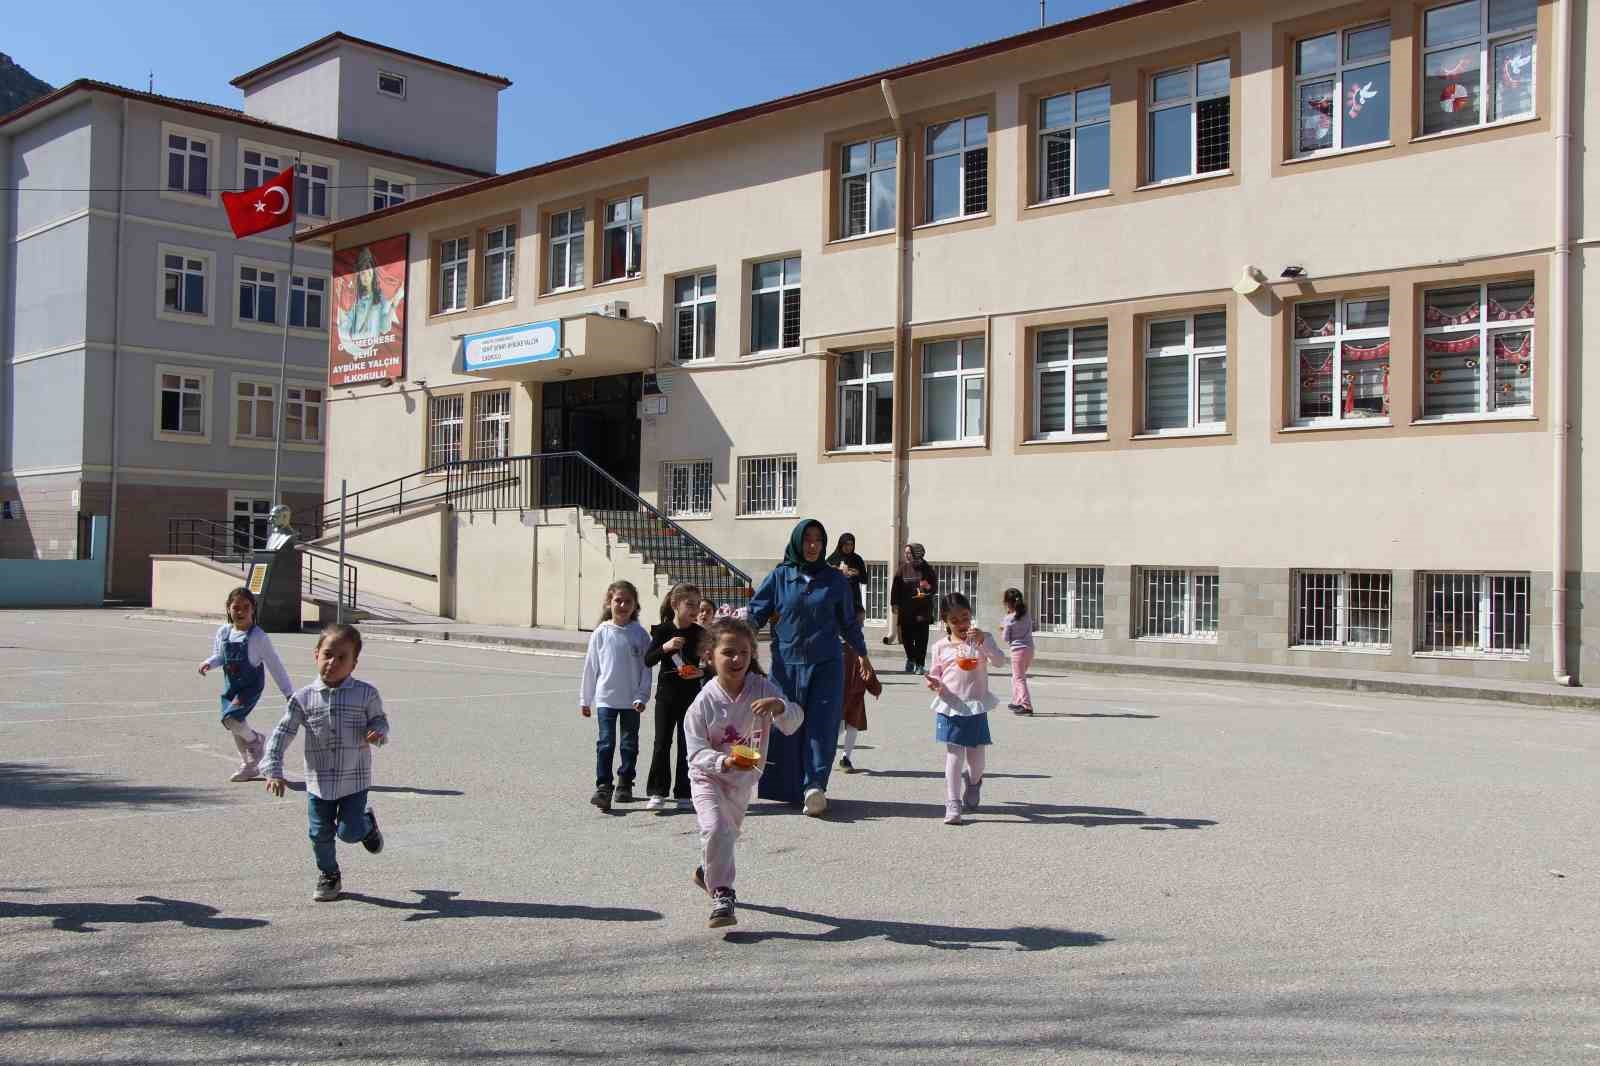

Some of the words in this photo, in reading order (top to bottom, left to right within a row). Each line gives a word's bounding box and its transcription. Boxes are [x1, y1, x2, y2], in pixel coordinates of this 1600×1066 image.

[332, 360, 366, 374] AYBÜKE
[367, 356, 401, 369] YALÇIN
[343, 369, 386, 384] İLKOKULU
